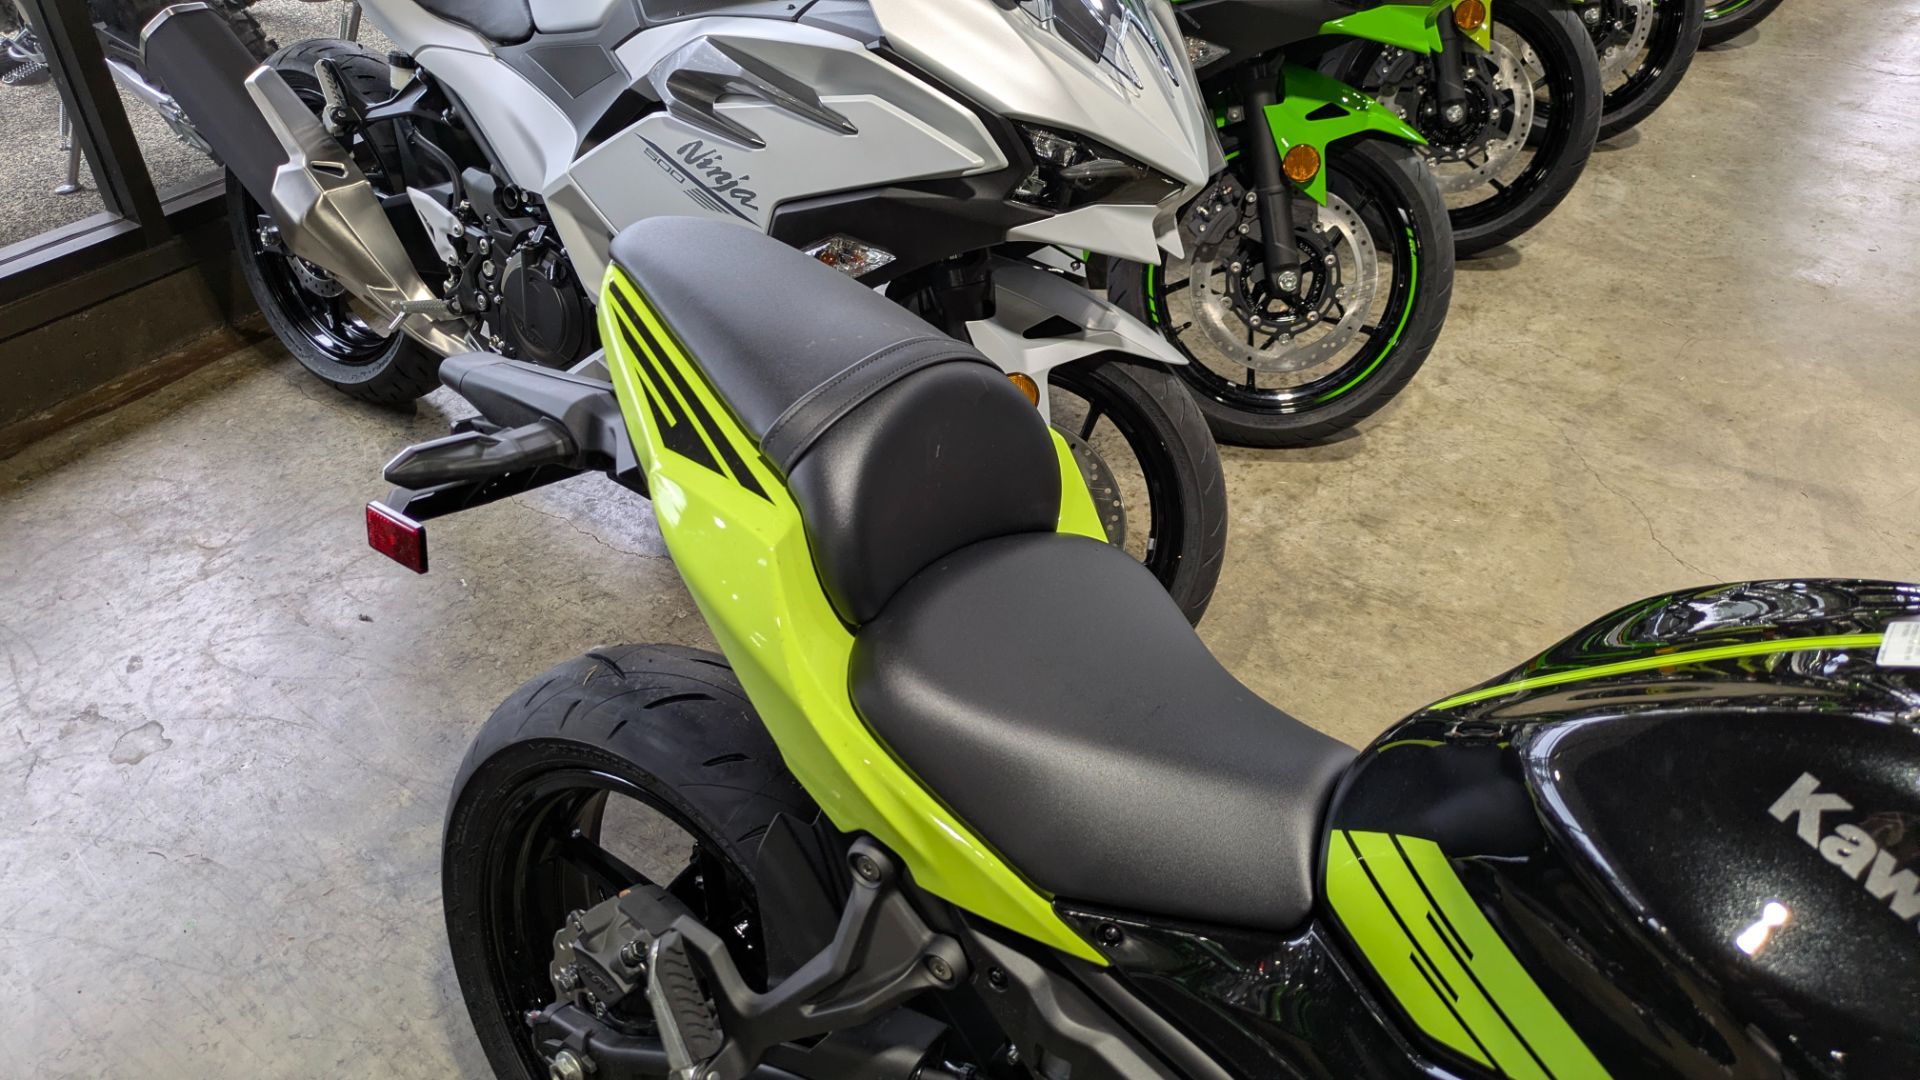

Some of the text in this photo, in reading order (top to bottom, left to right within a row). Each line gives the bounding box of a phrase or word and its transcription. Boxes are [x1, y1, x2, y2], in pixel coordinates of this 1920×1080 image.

[643, 147, 686, 184] 500
[676, 140, 759, 211] Ninja
[1767, 771, 1920, 930] Kaw
